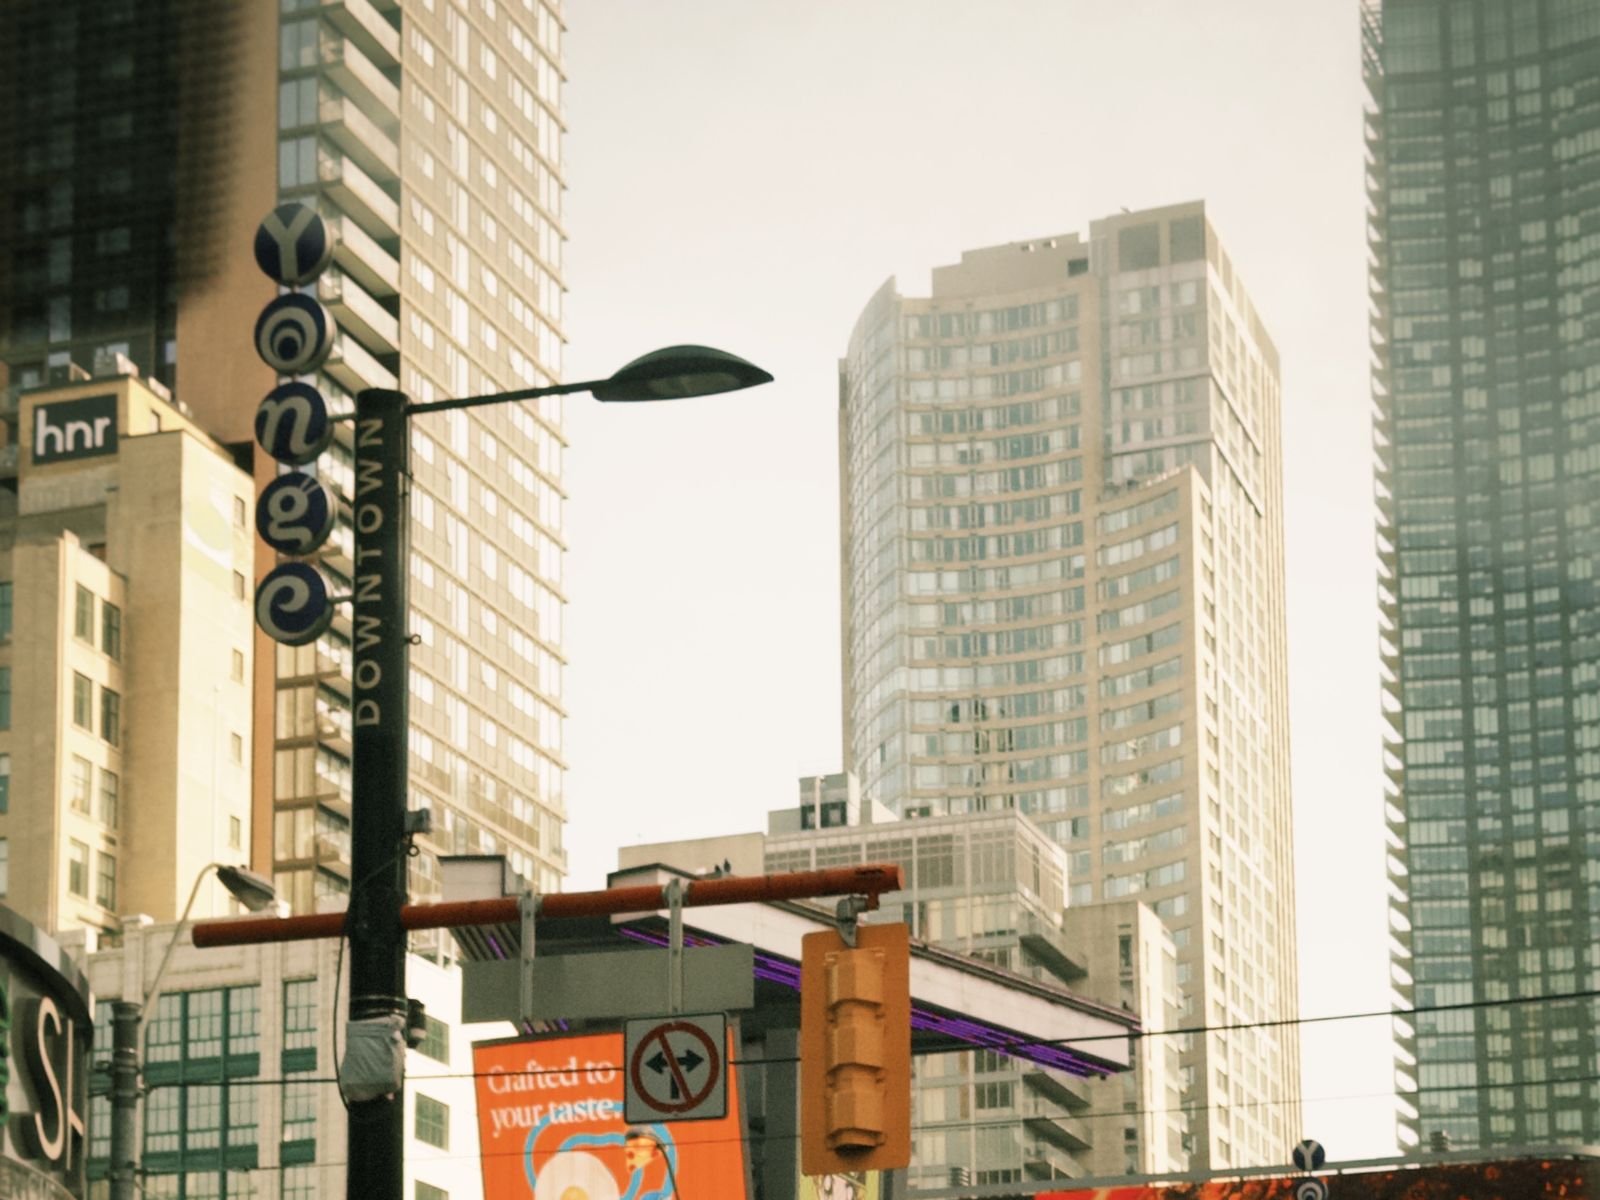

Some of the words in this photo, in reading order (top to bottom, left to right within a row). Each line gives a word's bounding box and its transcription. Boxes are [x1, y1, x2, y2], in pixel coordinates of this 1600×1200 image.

[36, 408, 111, 456] hnr
[257, 205, 323, 637] Yonge
[356, 417, 384, 727] DOWNTOWN
[487, 1056, 579, 1095] Crafted
[585, 1060, 617, 1085] to
[490, 1103, 544, 1139] your
[548, 1097, 623, 1126] taste.
